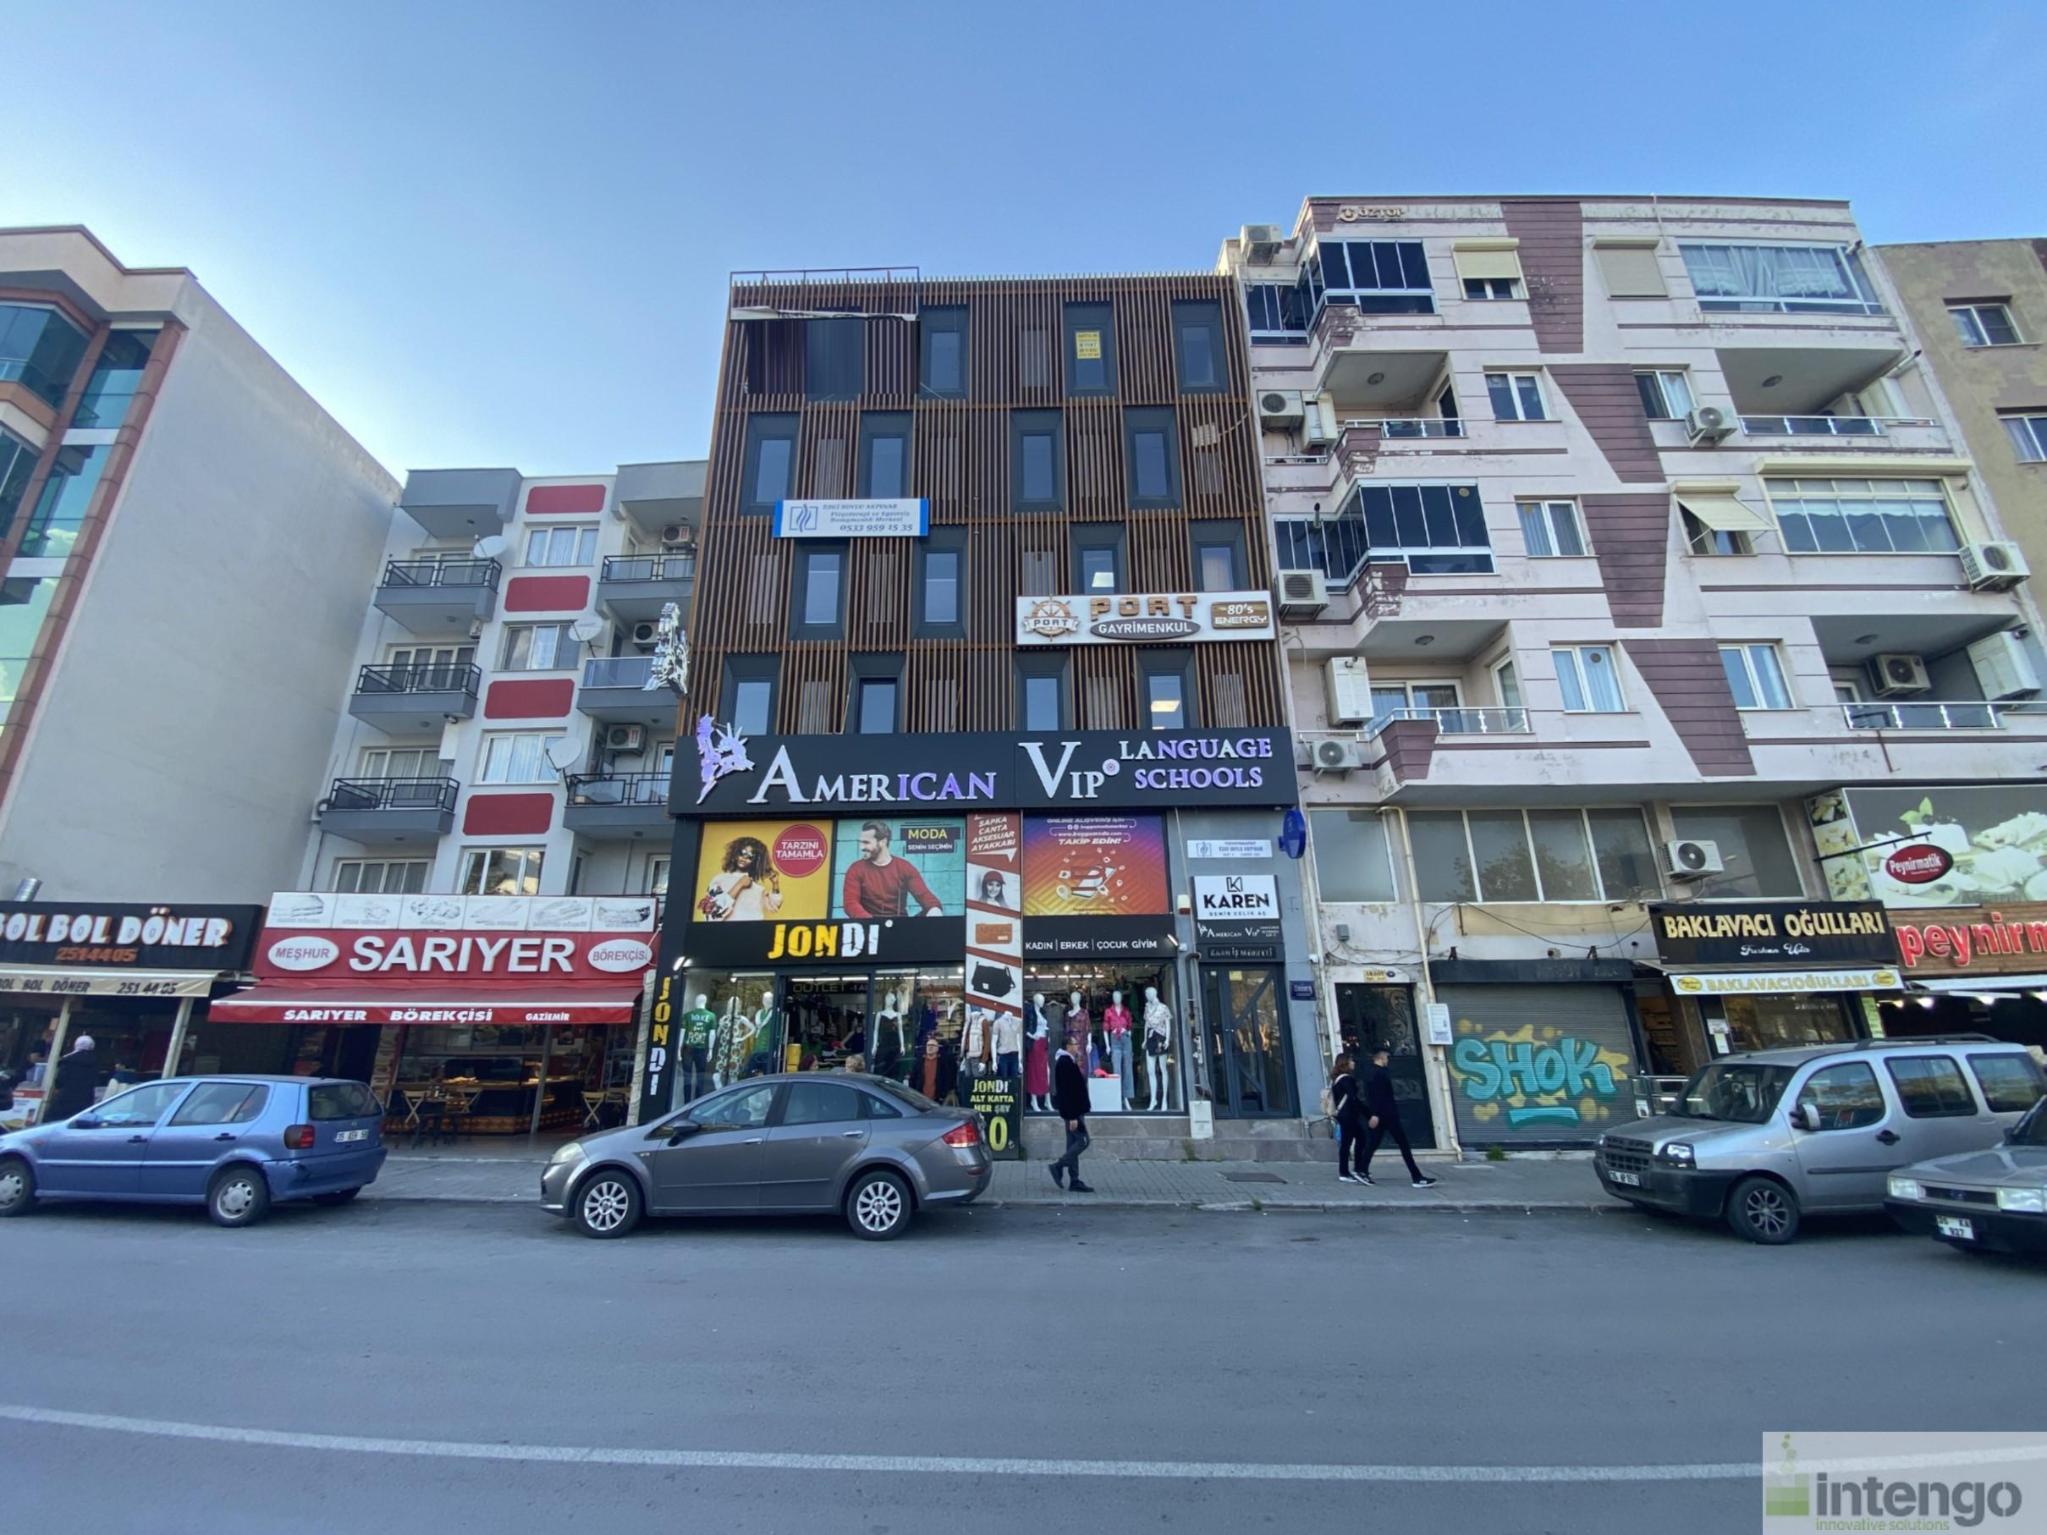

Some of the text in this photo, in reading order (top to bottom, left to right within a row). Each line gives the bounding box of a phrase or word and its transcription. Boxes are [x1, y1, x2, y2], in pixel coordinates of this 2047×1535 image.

[1090, 596, 1198, 621] PORT
[1033, 618, 1069, 627] PORT
[1098, 621, 1192, 634] GAYRİMENKUL
[1215, 615, 1267, 626] ENERGY
[1120, 737, 1273, 761] LANGUAGE
[1135, 766, 1263, 790] SCHOOLS
[908, 828, 948, 839] MODA
[776, 849, 824, 858] TAMAMLA
[1889, 853, 1943, 876] Peynirmatik
[1203, 894, 1269, 909] KAREN
[46, 914, 109, 943] BOL
[116, 907, 231, 947] DÖNER
[1664, 909, 1886, 939] BAKLAVACI OĞULLARI
[1025, 940, 1054, 951] KADIN
[1060, 939, 1089, 950] ERKEK
[1097, 938, 1158, 951] ÇOCUK GİYİM
[275, 946, 331, 962] MEŞHUR
[349, 936, 576, 973] SARIYER
[51, 977, 91, 992] DÖNER
[283, 1007, 570, 1024] SARIYER BÖREKÇİSİ GAZİEMİR
[1453, 1037, 1616, 1101] SHOK
[972, 1079, 1009, 1093] JONDI
[970, 1095, 1014, 1103] ALT KATTA
